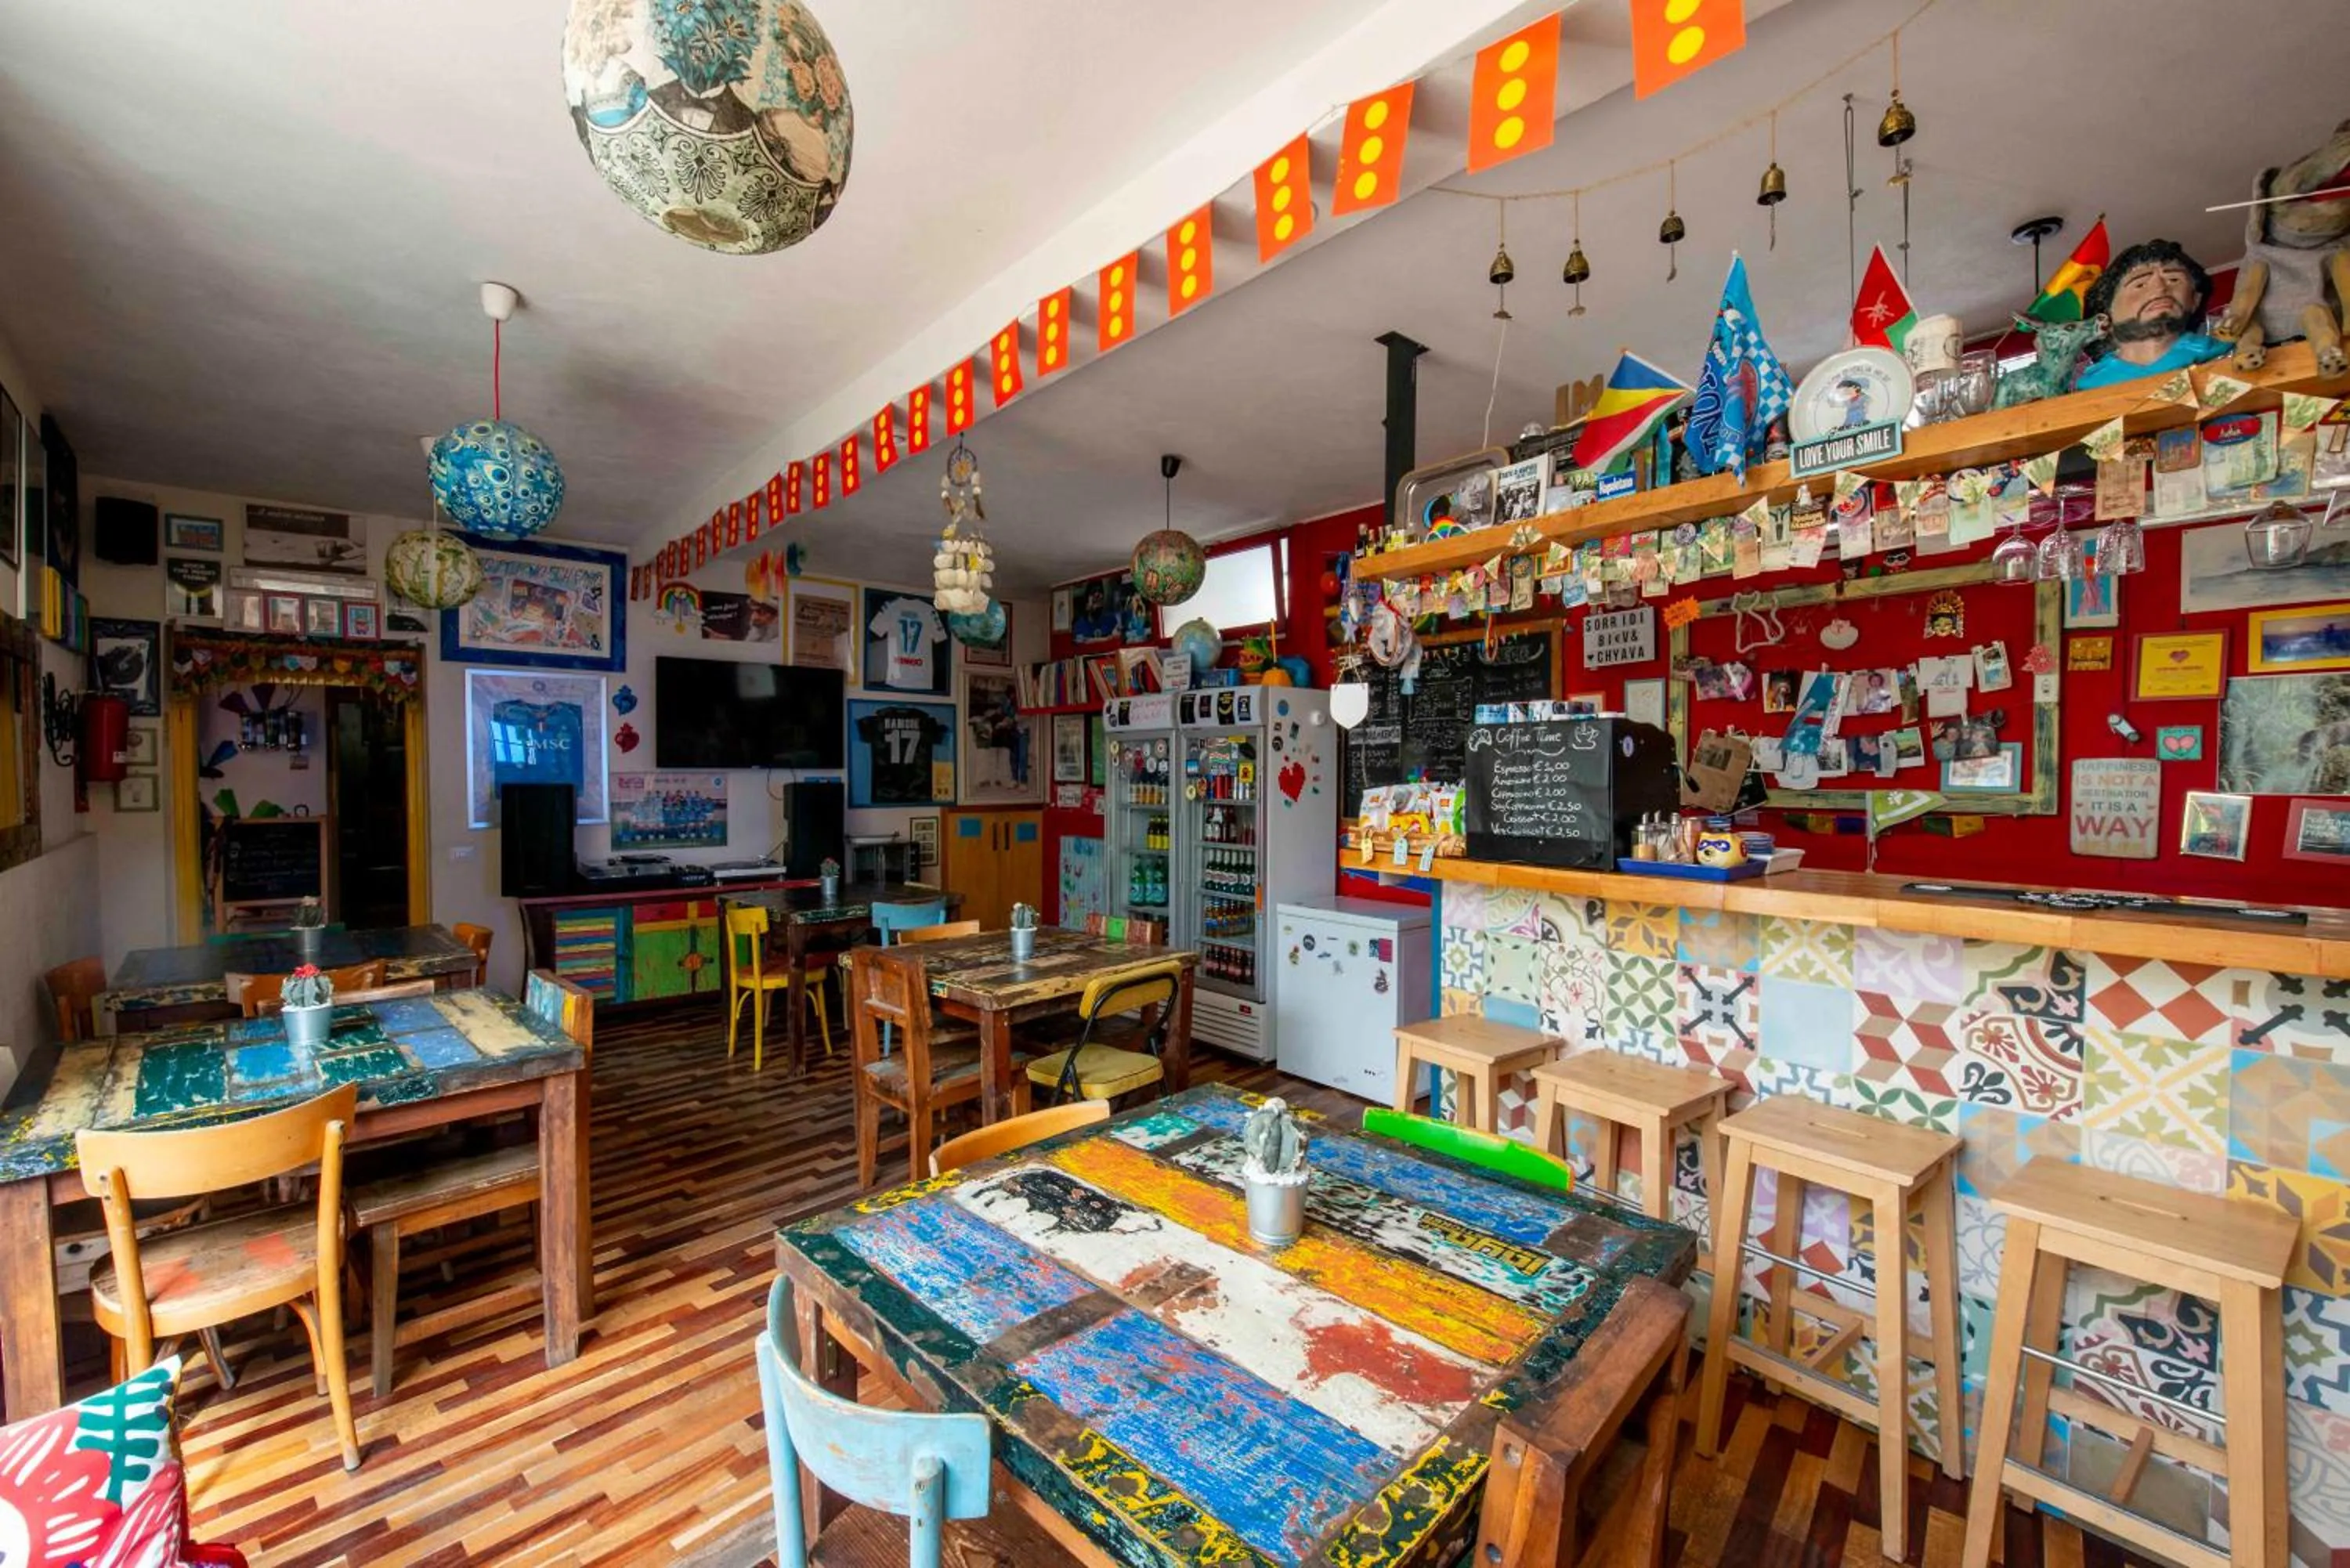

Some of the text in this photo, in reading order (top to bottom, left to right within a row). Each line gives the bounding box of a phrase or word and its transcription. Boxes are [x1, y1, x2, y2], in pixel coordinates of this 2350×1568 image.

[1799, 428, 1891, 468] LOVE YOUR SMILE
[898, 619, 923, 654] 17
[534, 739, 570, 750] MSC
[884, 729, 920, 765] 17
[1495, 728, 1531, 749] Coffee
[2097, 774, 2138, 786] NOT
[2143, 775, 2157, 786] A
[2091, 801, 2138, 813] IT IS A
[2075, 815, 2154, 839] WAY
